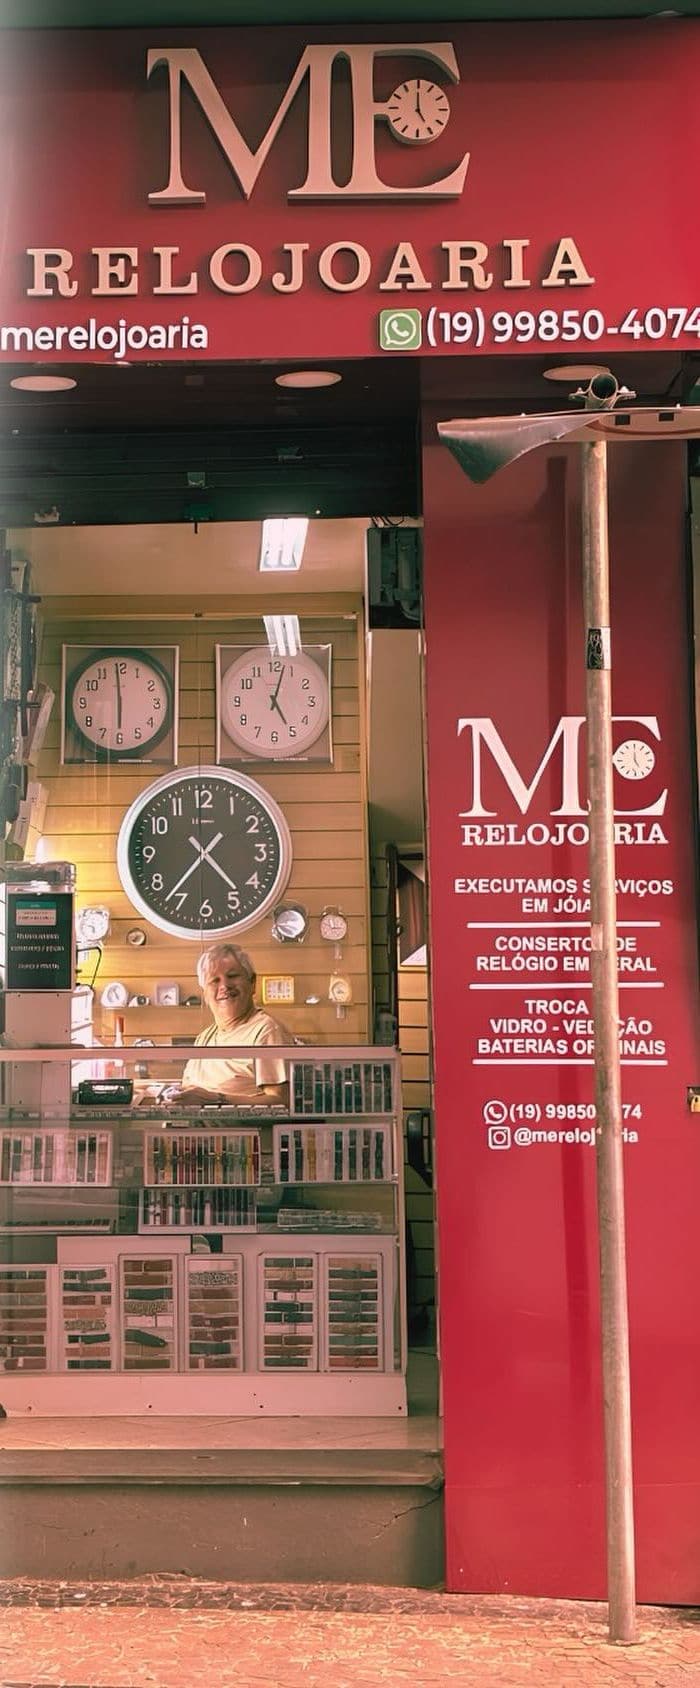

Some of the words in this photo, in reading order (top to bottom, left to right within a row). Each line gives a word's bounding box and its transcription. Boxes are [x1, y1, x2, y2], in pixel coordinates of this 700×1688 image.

[147, 43, 469, 205] ME
[27, 237, 595, 297] RELOJOARIA
[427, 307, 485, 346] (19)
[492, 307, 700, 342] 99850-4074
[1, 316, 208, 358] merelojoaria
[97, 668, 107, 679] 11
[135, 668, 140, 678] 1
[252, 666, 261, 677] 11
[268, 661, 281, 672] 12
[289, 665, 294, 677] 1
[86, 680, 98, 691] 10
[147, 680, 155, 692] 2
[241, 679, 252, 689] 10
[301, 679, 310, 689] 2
[80, 698, 87, 709] 9
[153, 698, 161, 709] 3
[233, 696, 240, 707] 9
[307, 696, 316, 707] 3
[85, 716, 93, 727] 8
[147, 717, 154, 728] 4
[240, 714, 247, 725] 8
[301, 715, 308, 725] 4
[99, 728, 107, 739] 7
[116, 733, 123, 744] 6
[134, 728, 142, 740] 5
[254, 726, 261, 738] 7
[270, 731, 278, 743] 6
[288, 726, 297, 737] 5
[194, 790, 213, 808] 12
[229, 796, 234, 816] 1
[172, 797, 183, 816] 11
[152, 816, 168, 834] 10
[245, 815, 259, 833] 2
[461, 823, 668, 846] RELOJORIA
[142, 846, 155, 863] 9
[254, 843, 267, 862] 3
[151, 873, 163, 891] 8
[245, 871, 260, 889] 4
[454, 879, 577, 894] EXECUTAMOS
[582, 879, 674, 897] SVIÇOS
[174, 893, 188, 911] 7
[227, 891, 240, 910] 5
[522, 898, 548, 912] EM
[200, 899, 213, 917] 6
[476, 953, 558, 971] RELÓGIO
[563, 956, 589, 971] EM
[525, 1000, 589, 1014] TROCA
[490, 1019, 546, 1034] VIDRO
[478, 1039, 568, 1054] BATERIAS
[510, 1103, 541, 1122] (19)
